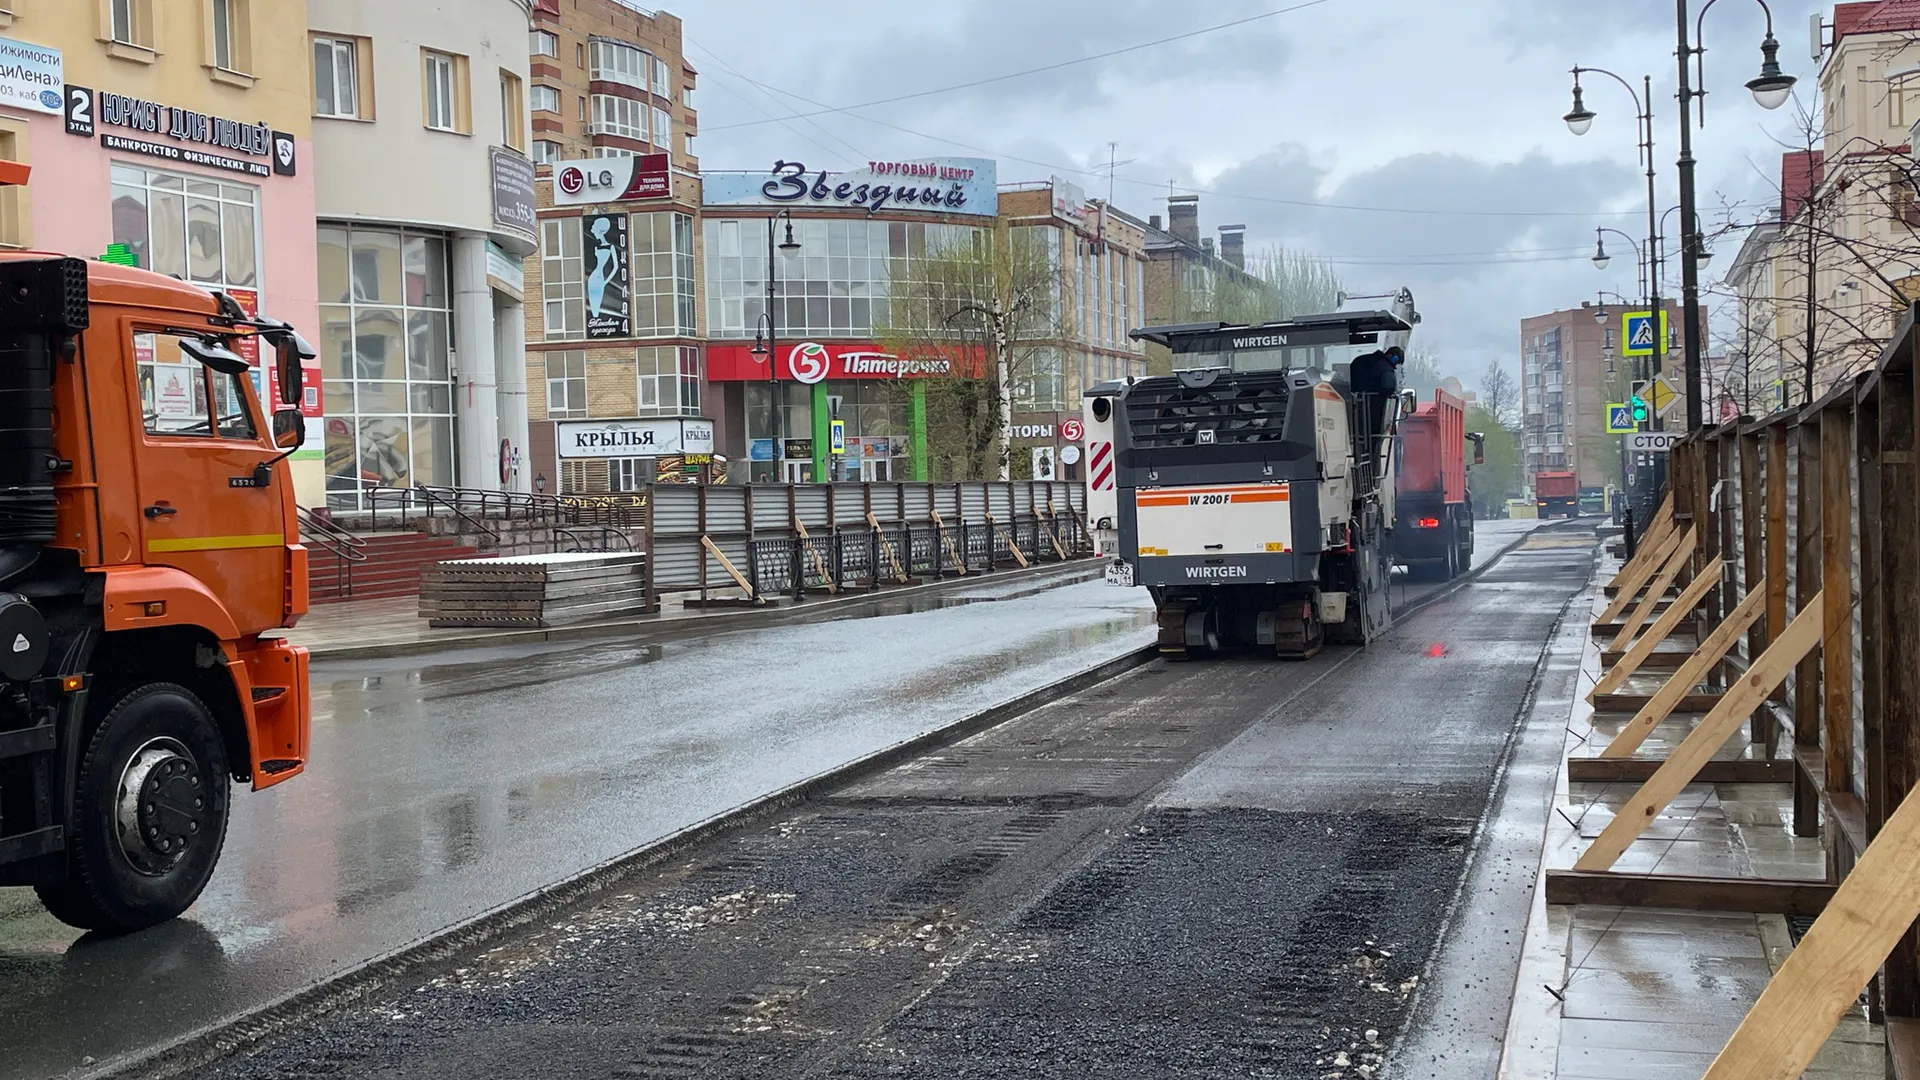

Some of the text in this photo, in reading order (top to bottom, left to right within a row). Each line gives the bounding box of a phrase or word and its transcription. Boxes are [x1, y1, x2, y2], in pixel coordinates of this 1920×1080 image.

[71, 90, 90, 123] 2
[69, 122, 93, 133] ЭТАЖ
[102, 91, 272, 156] ЮРИСТ ДЛЯ ЛЮДЕЙ
[107, 136, 269, 176] БАНКРОТСТВО ФИЗИЧЕСКИХ ЛИЦ
[868, 161, 974, 180] ТОРГОВЫЙ ЦЕНТР
[587, 170, 614, 188] LG
[761, 159, 968, 214] Звездный
[1233, 335, 1288, 348] WIRTGEN
[575, 431, 655, 447] КРЫЛЬЯ
[685, 430, 711, 441] КРЫЛЬЯ
[685, 454, 711, 465] ШАУРМА
[1190, 494, 1230, 505] W 200 F
[1108, 566, 1130, 575] 4352
[1185, 566, 1247, 578] WIRTGEN
[1123, 576, 1132, 584] 11
